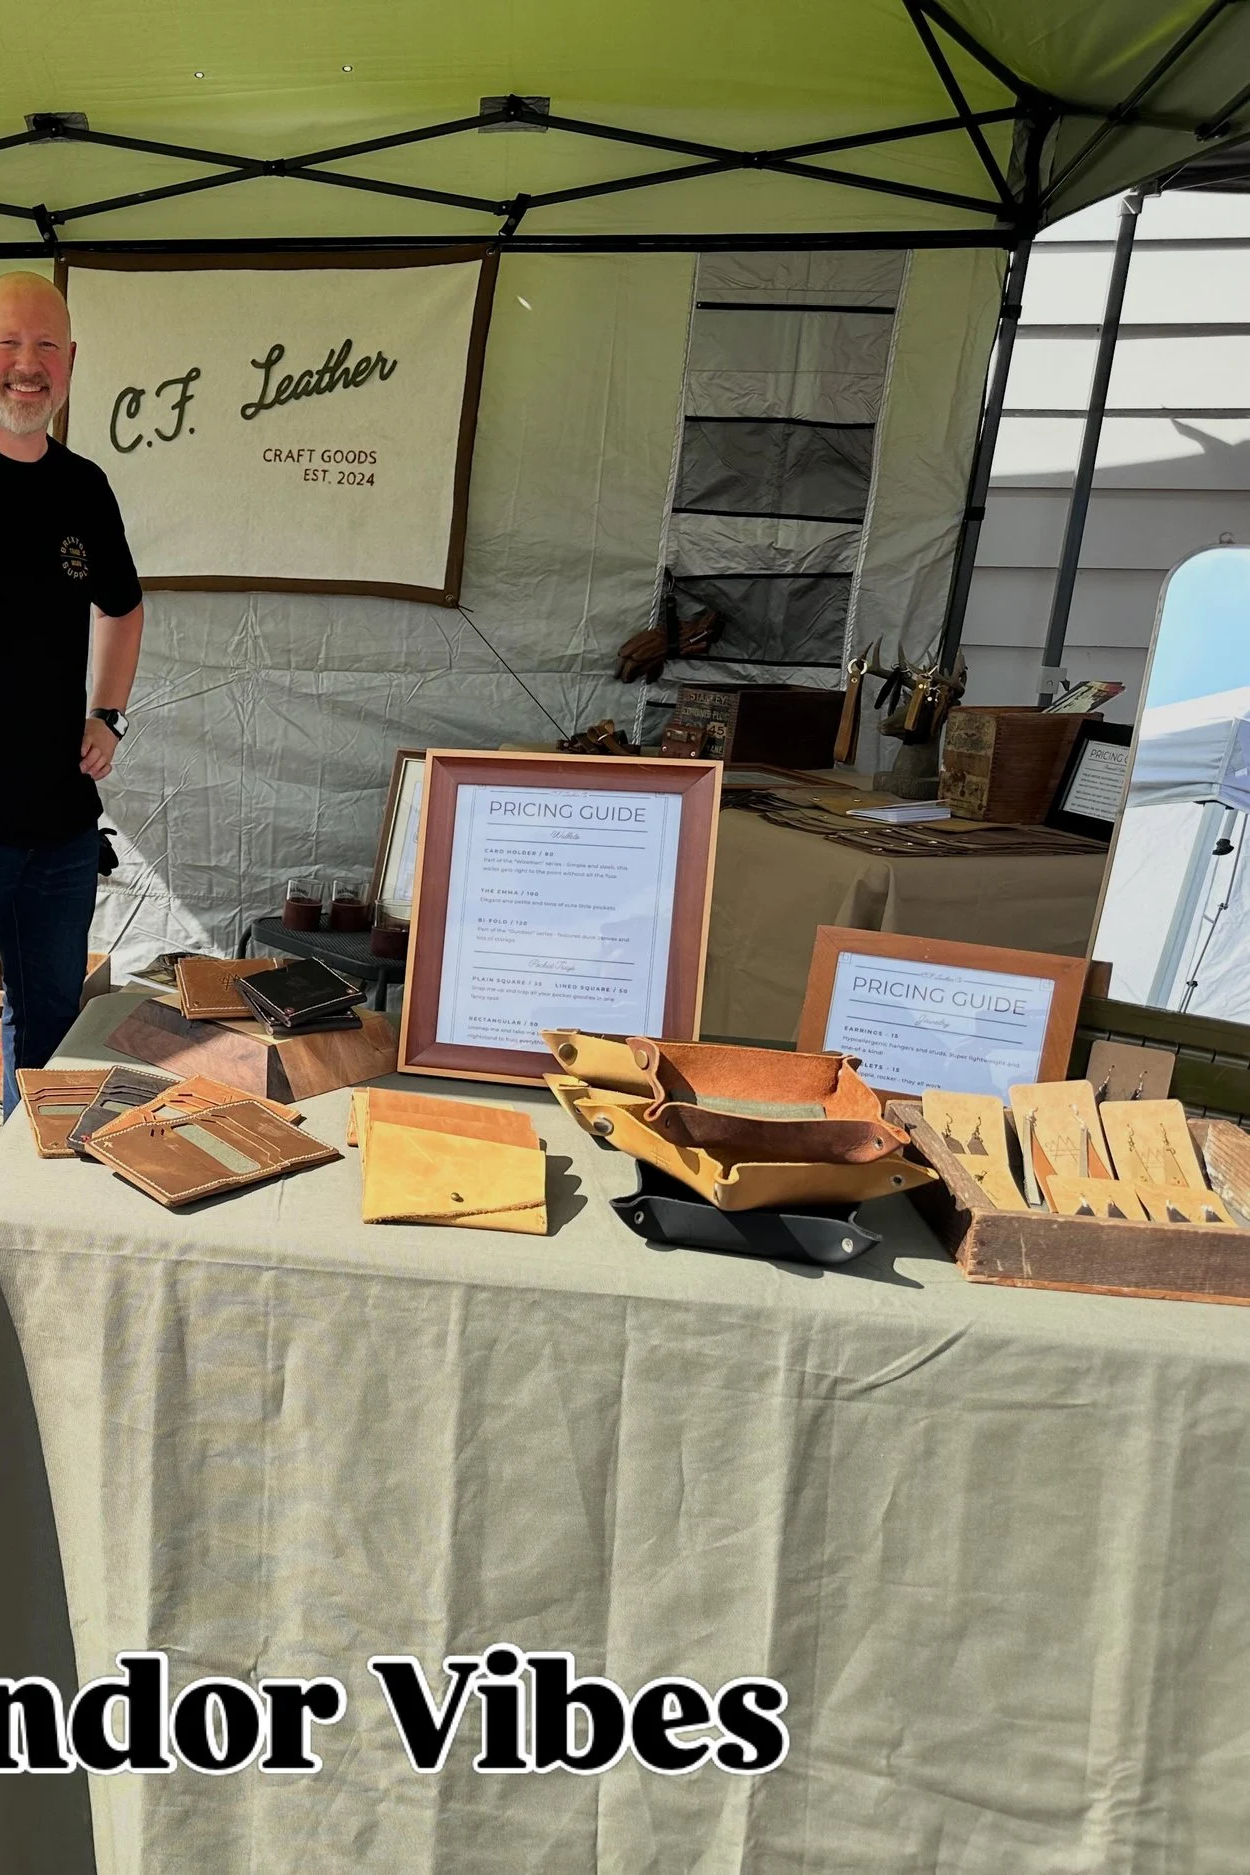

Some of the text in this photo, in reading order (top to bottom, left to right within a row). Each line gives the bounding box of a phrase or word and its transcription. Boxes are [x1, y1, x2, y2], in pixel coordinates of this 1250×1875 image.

[240, 339, 398, 420] Leather
[262, 448, 378, 465] CRAFT GOODS
[302, 469, 376, 487] EST. 2024
[60, 536, 87, 557] BRIXTON
[62, 561, 89, 580] SUPPLY
[709, 724, 725, 736] 45
[1090, 748, 1123, 763] PRICING
[489, 801, 646, 822] PRICING GUIDE
[580, 985, 610, 993] SQUARE
[853, 976, 945, 1004] PRICING
[951, 990, 1028, 1016] GUIDE
[469, 1016, 521, 1025] RECTANGULAR
[844, 1026, 883, 1036] EARRINGS
[889, 1043, 914, 1052] hangers
